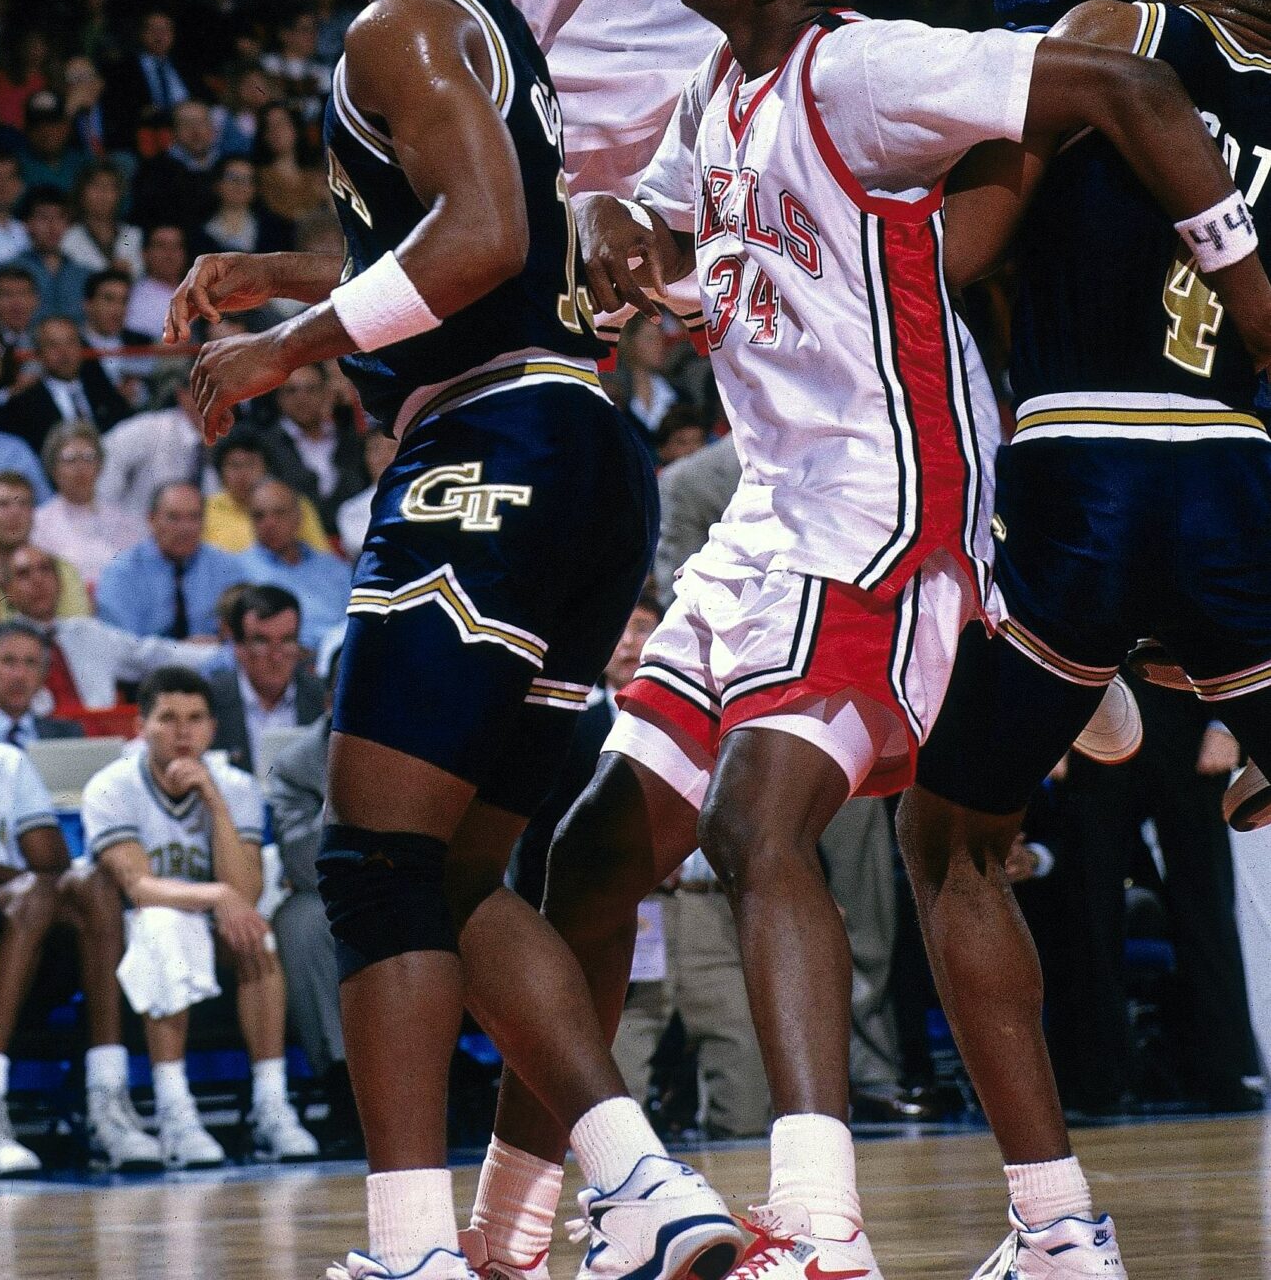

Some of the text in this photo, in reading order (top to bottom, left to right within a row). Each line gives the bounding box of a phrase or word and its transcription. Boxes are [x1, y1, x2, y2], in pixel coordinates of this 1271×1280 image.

[705, 254, 779, 351] 34
[1162, 258, 1224, 378] 4
[399, 460, 532, 531] GT
